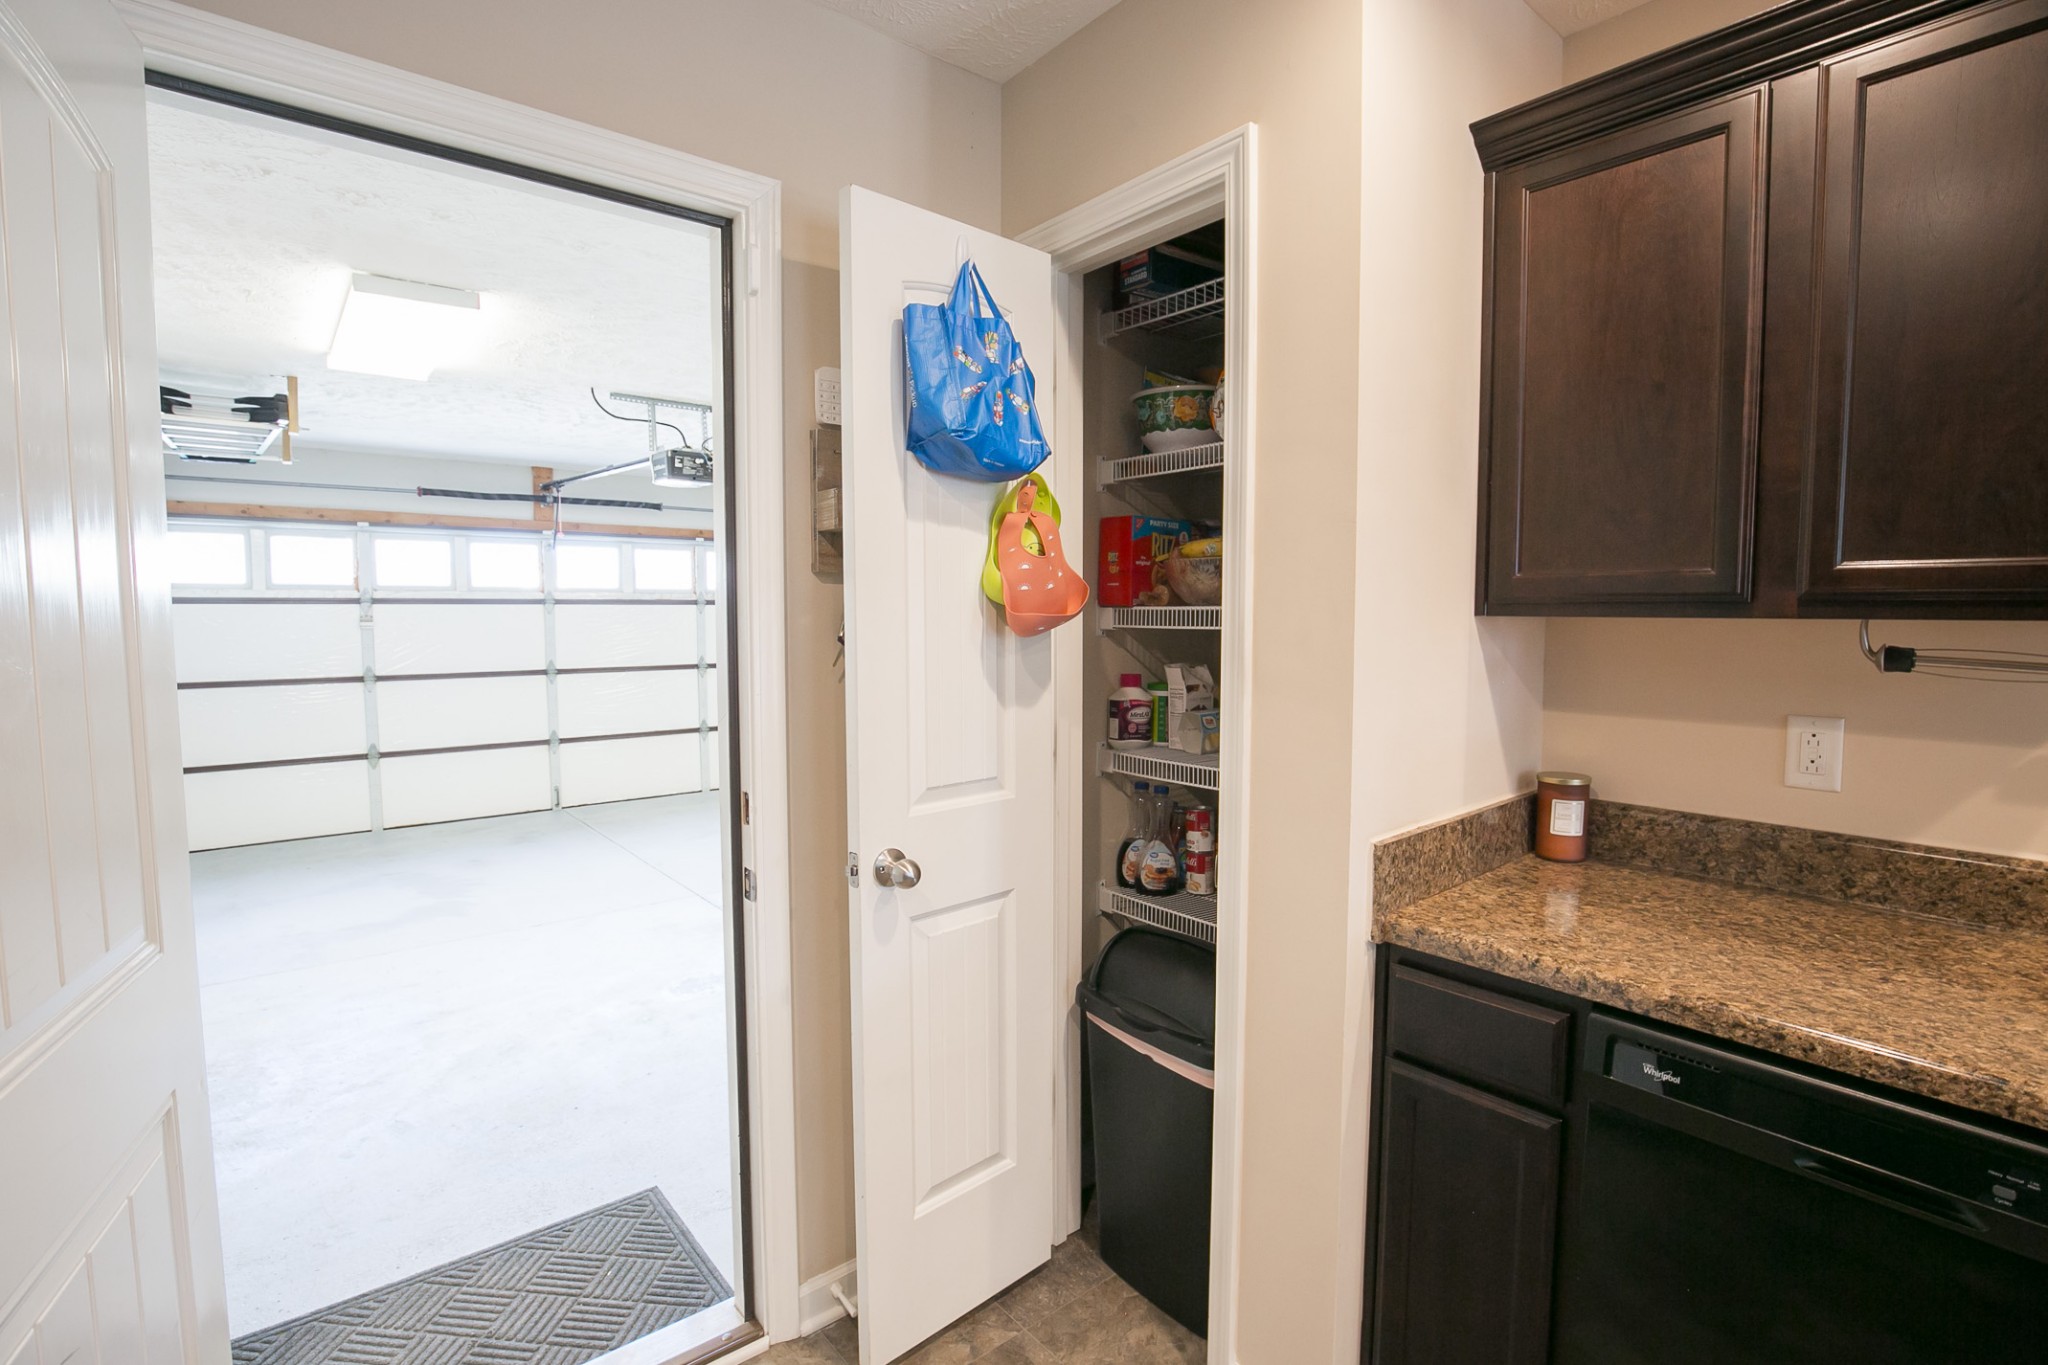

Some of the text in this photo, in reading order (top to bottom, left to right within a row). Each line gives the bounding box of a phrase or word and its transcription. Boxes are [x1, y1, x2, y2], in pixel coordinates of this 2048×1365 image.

[1150, 519, 1167, 527] PARTY
[1152, 532, 1176, 557] RITZ
[1643, 1063, 1681, 1084] Whirlpool
